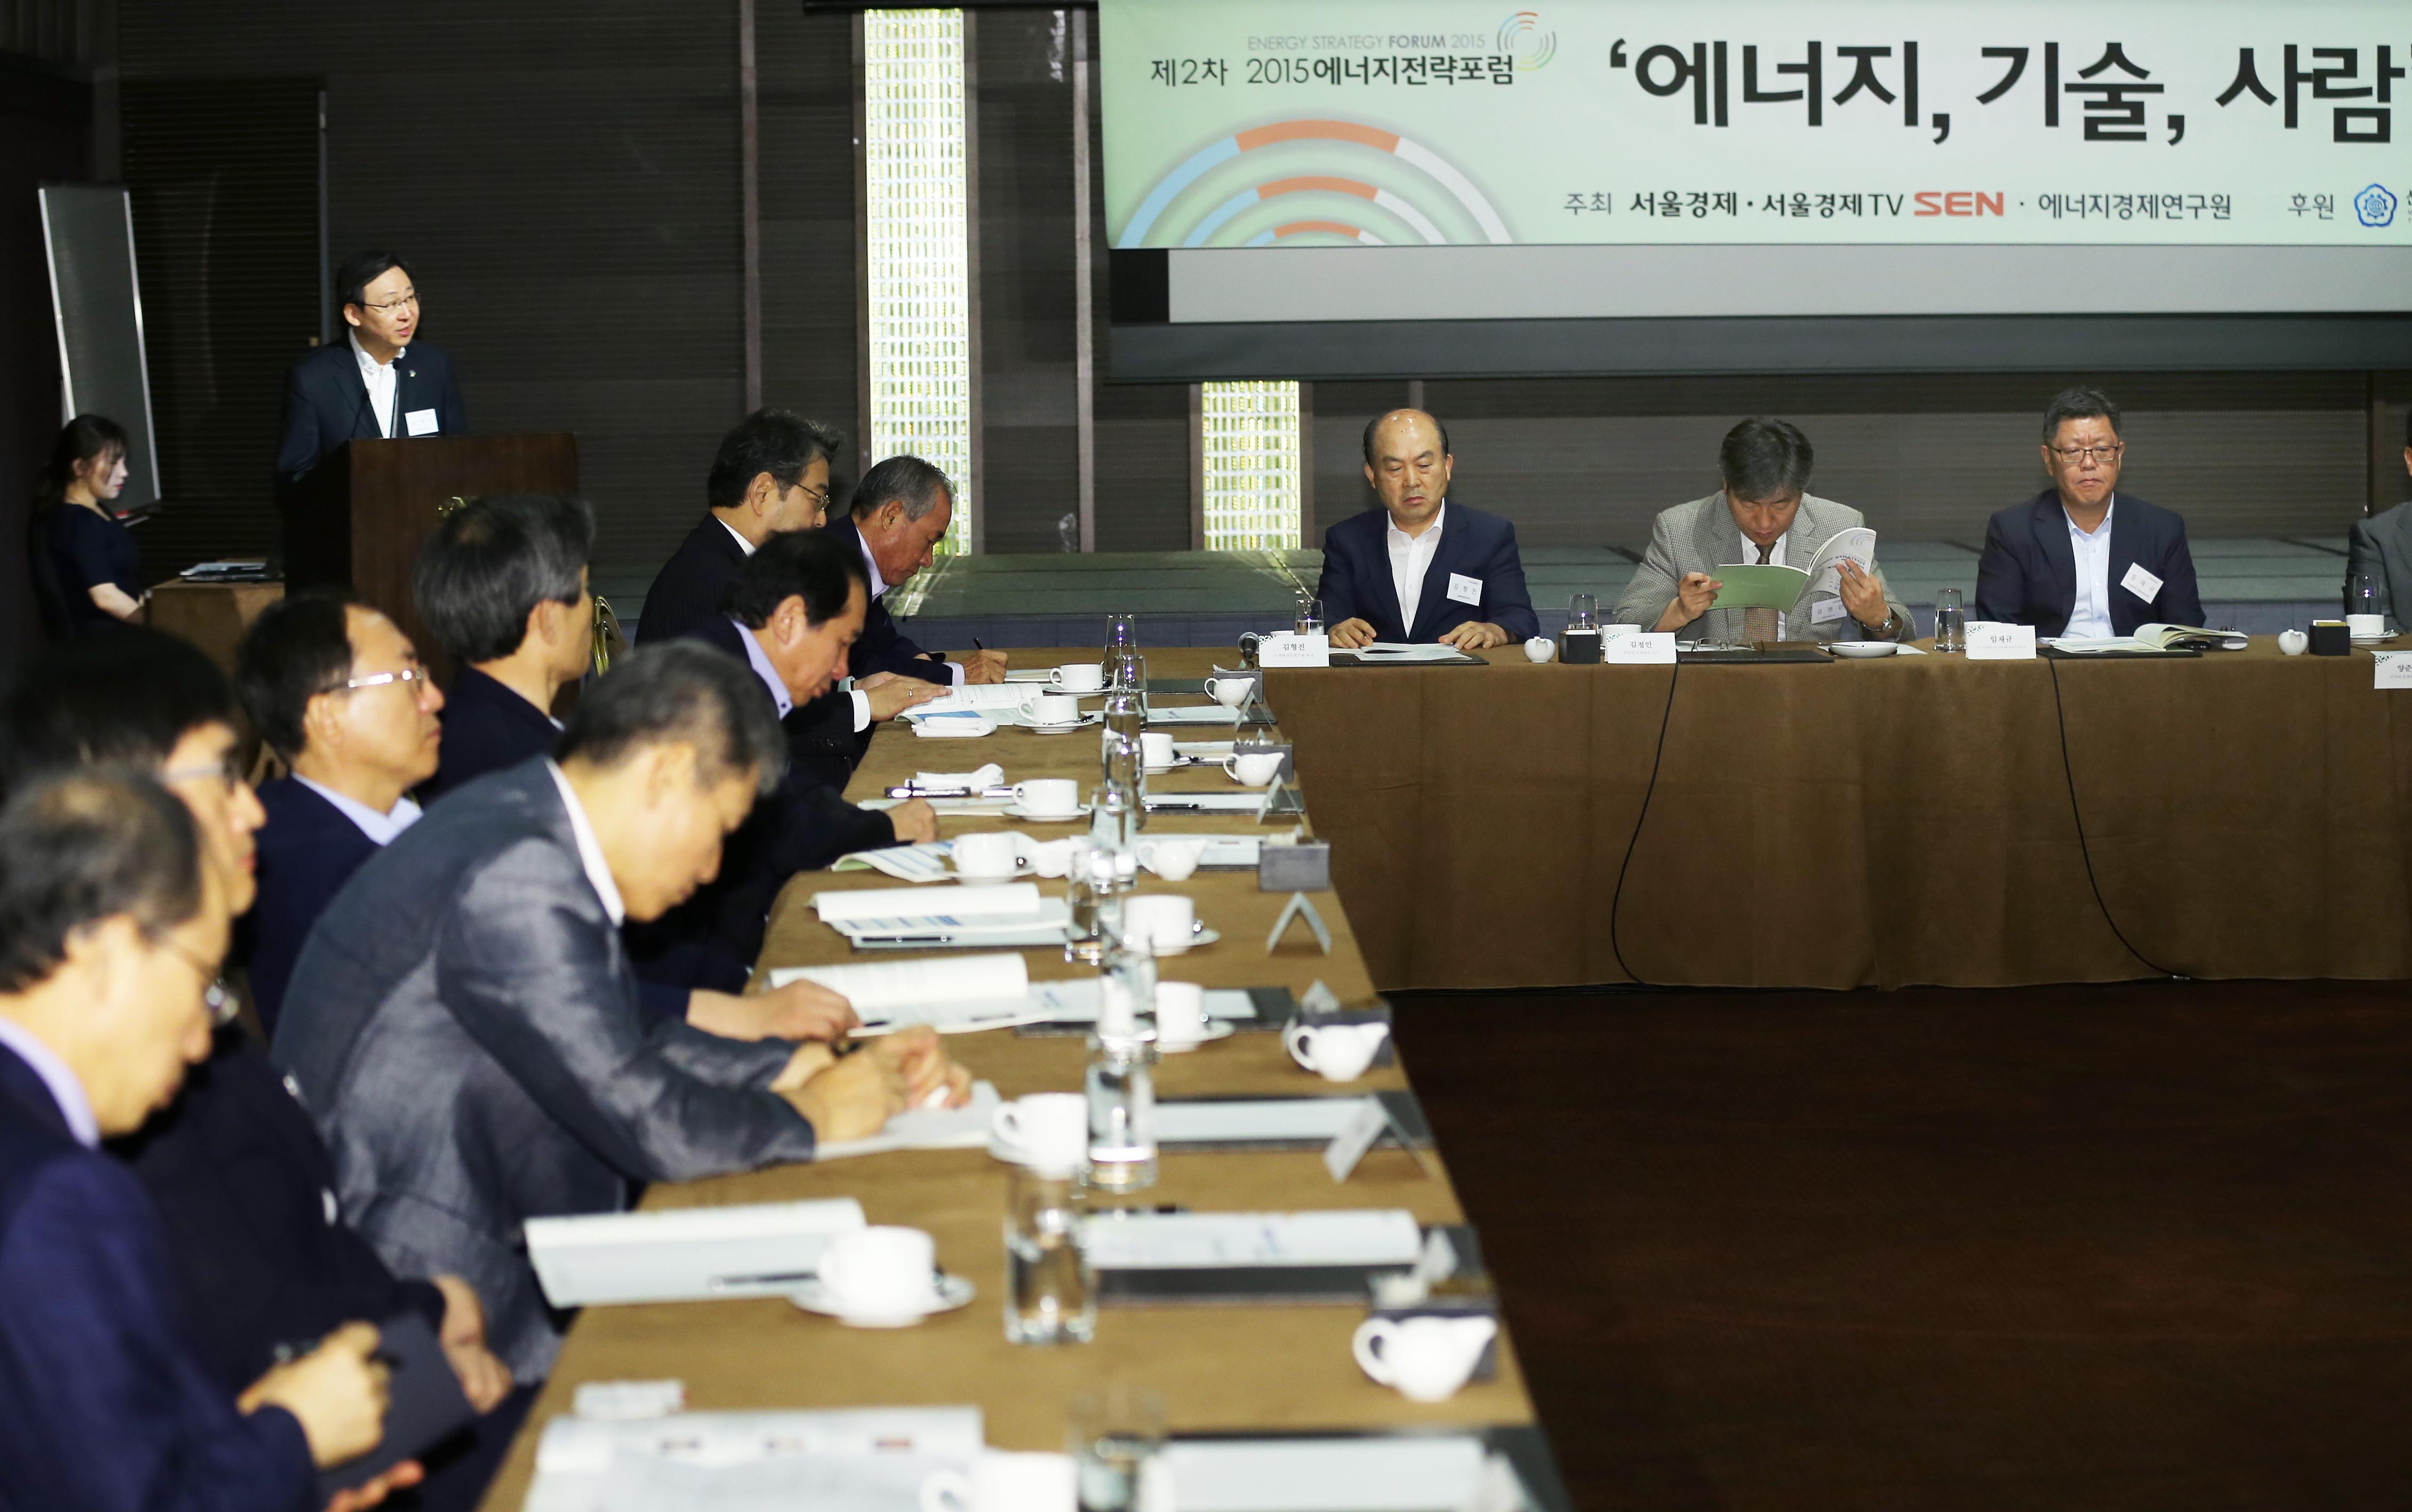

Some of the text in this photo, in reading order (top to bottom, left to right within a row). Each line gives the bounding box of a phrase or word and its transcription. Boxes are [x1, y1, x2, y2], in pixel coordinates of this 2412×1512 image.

[1247, 34, 1485, 51] ENERGY STRATEGY FORUM 2015
[1151, 54, 1513, 87] 제2차 2015에너지전략포럼
[1975, 41, 2185, 146] 기술,
[2215, 44, 2412, 144] 사람
[1564, 192, 1612, 216] 주최
[1913, 192, 2004, 217] SEN
[2038, 193, 2231, 220] 에너지경제연구원
[2288, 193, 2334, 220] 후원
